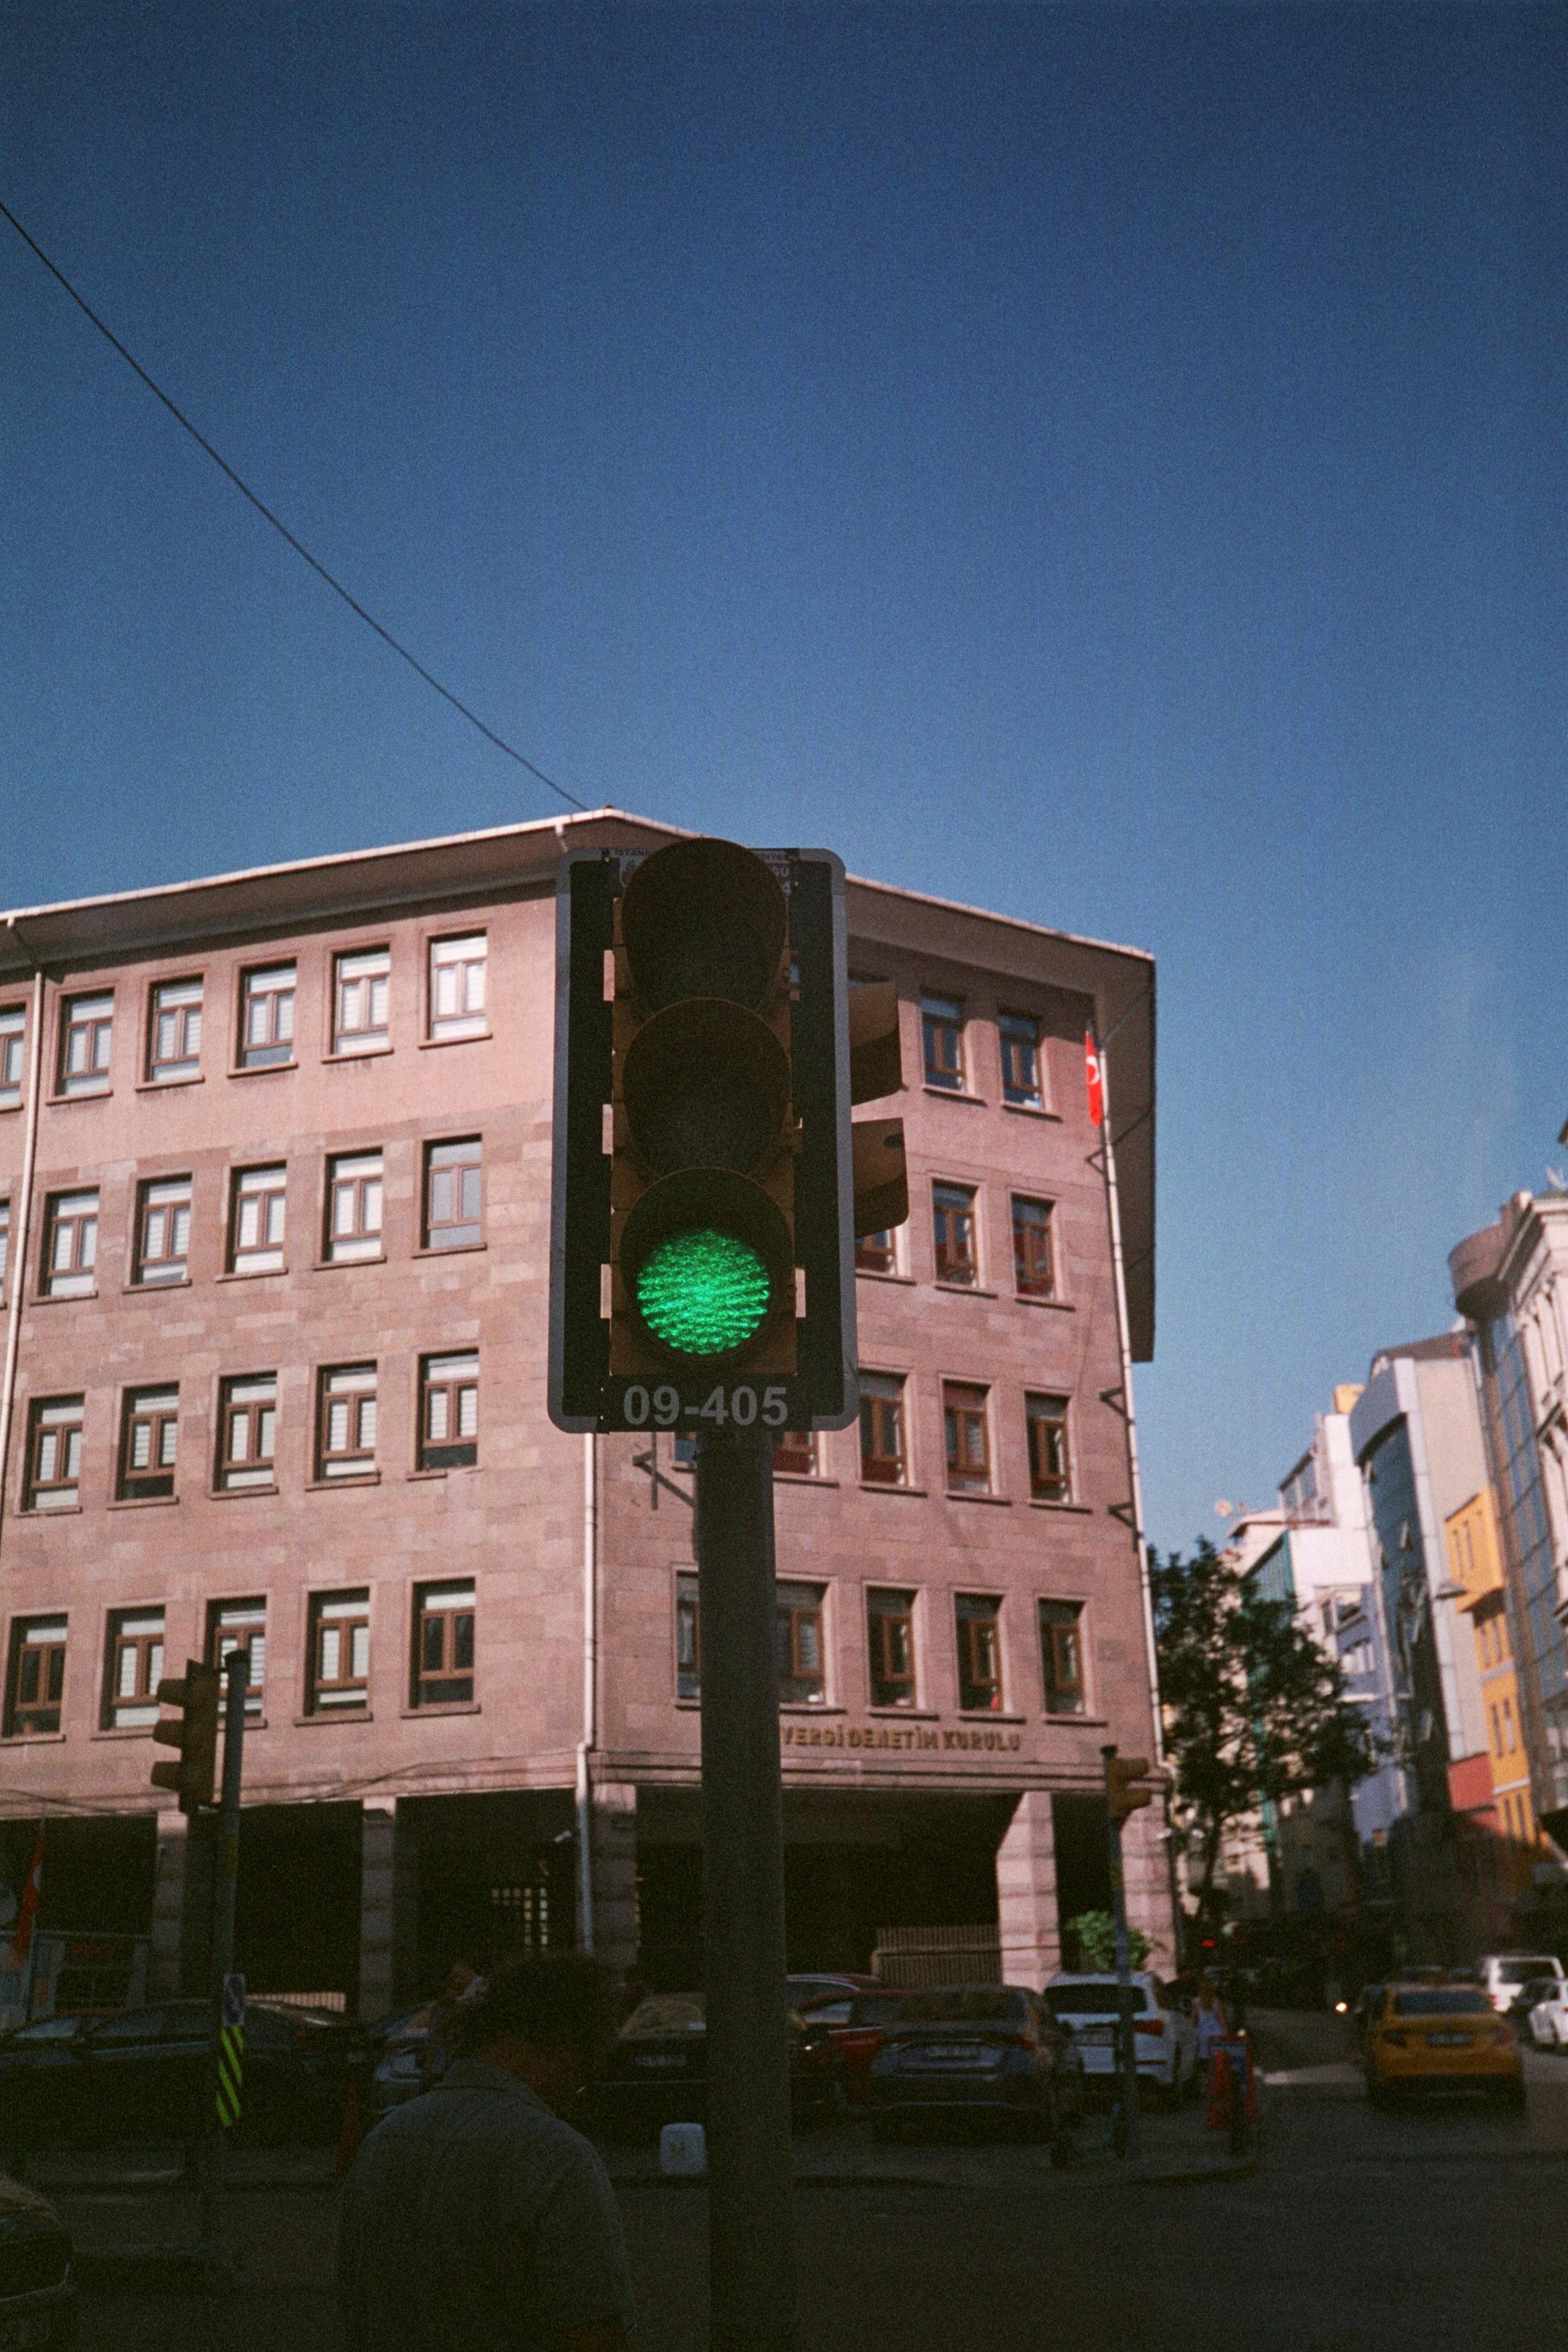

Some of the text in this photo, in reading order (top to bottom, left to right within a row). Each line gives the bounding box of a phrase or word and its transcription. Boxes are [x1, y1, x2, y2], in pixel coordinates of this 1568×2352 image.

[623, 1385, 788, 1425] 09-405
[849, 1725, 938, 1750] DENETİM
[942, 1731, 1019, 1751] KURULU
